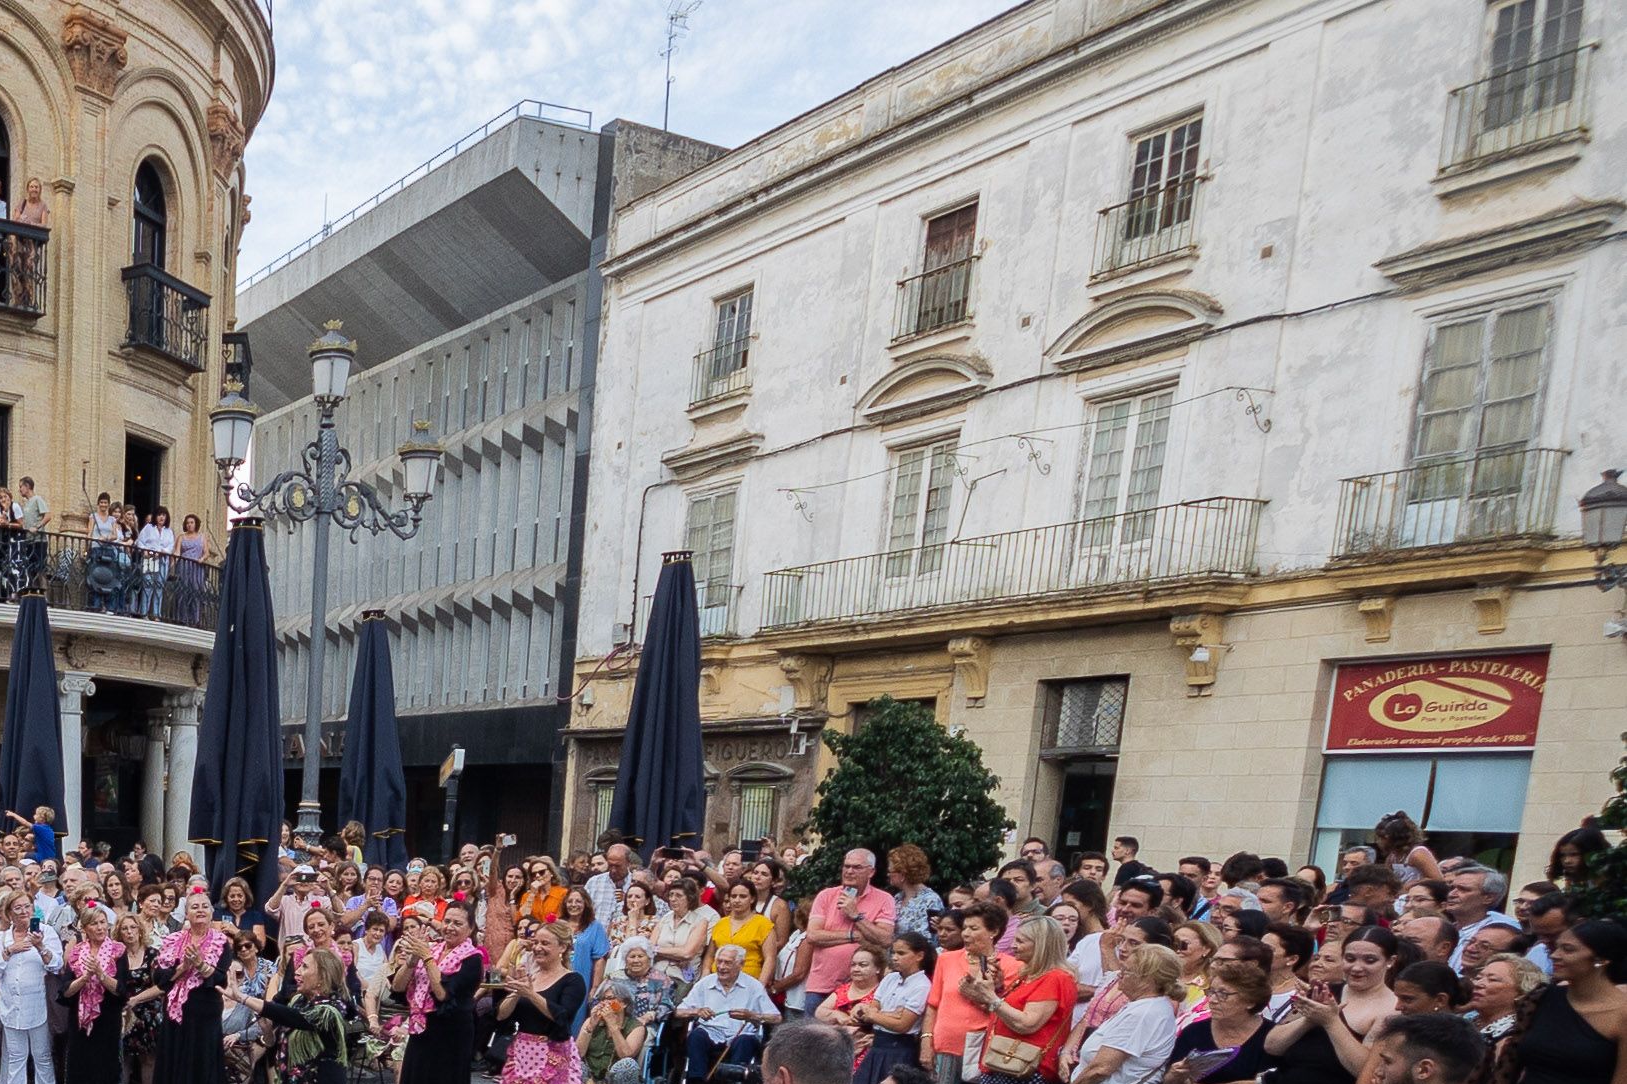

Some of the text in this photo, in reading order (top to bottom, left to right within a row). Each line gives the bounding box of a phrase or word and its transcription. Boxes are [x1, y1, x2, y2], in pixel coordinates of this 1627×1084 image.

[1343, 663, 1436, 701] PANADERIA
[1448, 660, 1547, 693] PASTELERIA
[1393, 700, 1488, 715] La Guinda
[705, 740, 802, 761] FIGUERO
